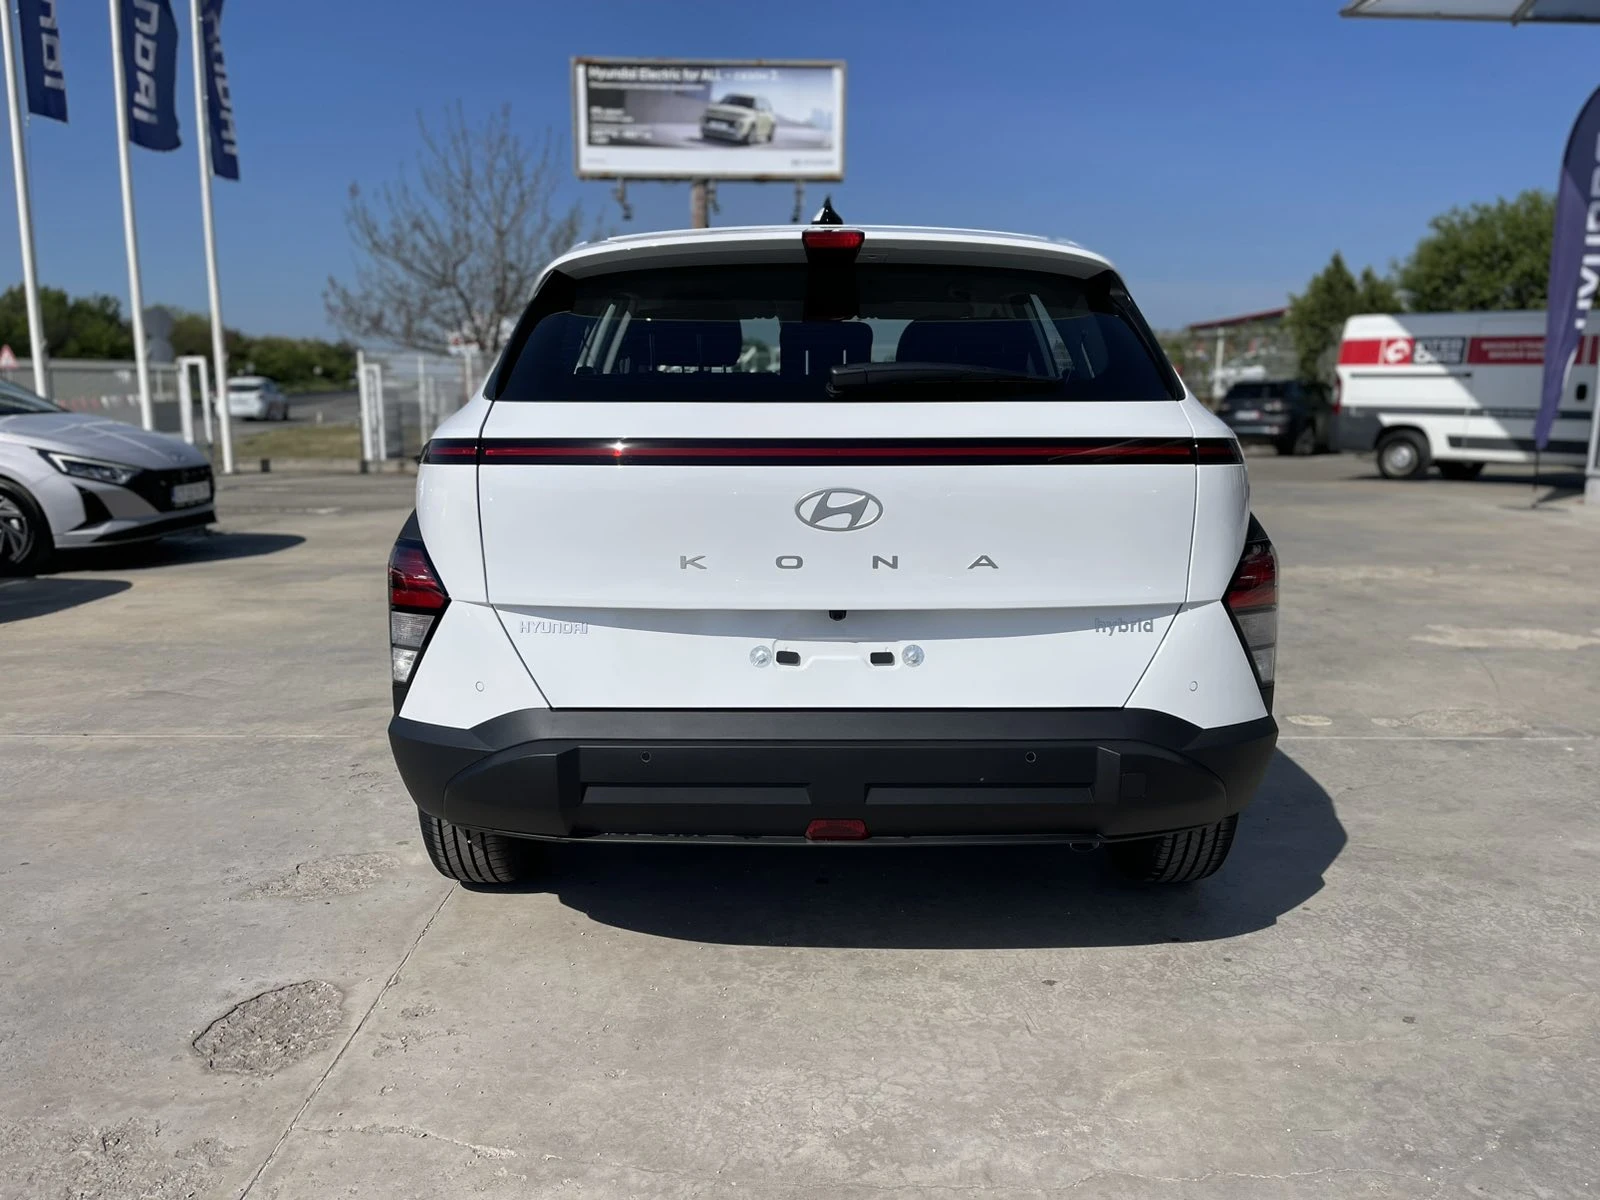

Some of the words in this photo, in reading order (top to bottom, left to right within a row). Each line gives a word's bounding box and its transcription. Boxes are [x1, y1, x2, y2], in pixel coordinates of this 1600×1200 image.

[587, 66, 637, 82] Hyundai
[639, 67, 681, 82] Electric
[680, 554, 1000, 570] KONA
[519, 621, 588, 635] HYUNDAI
[1094, 618, 1154, 637] hybrid
